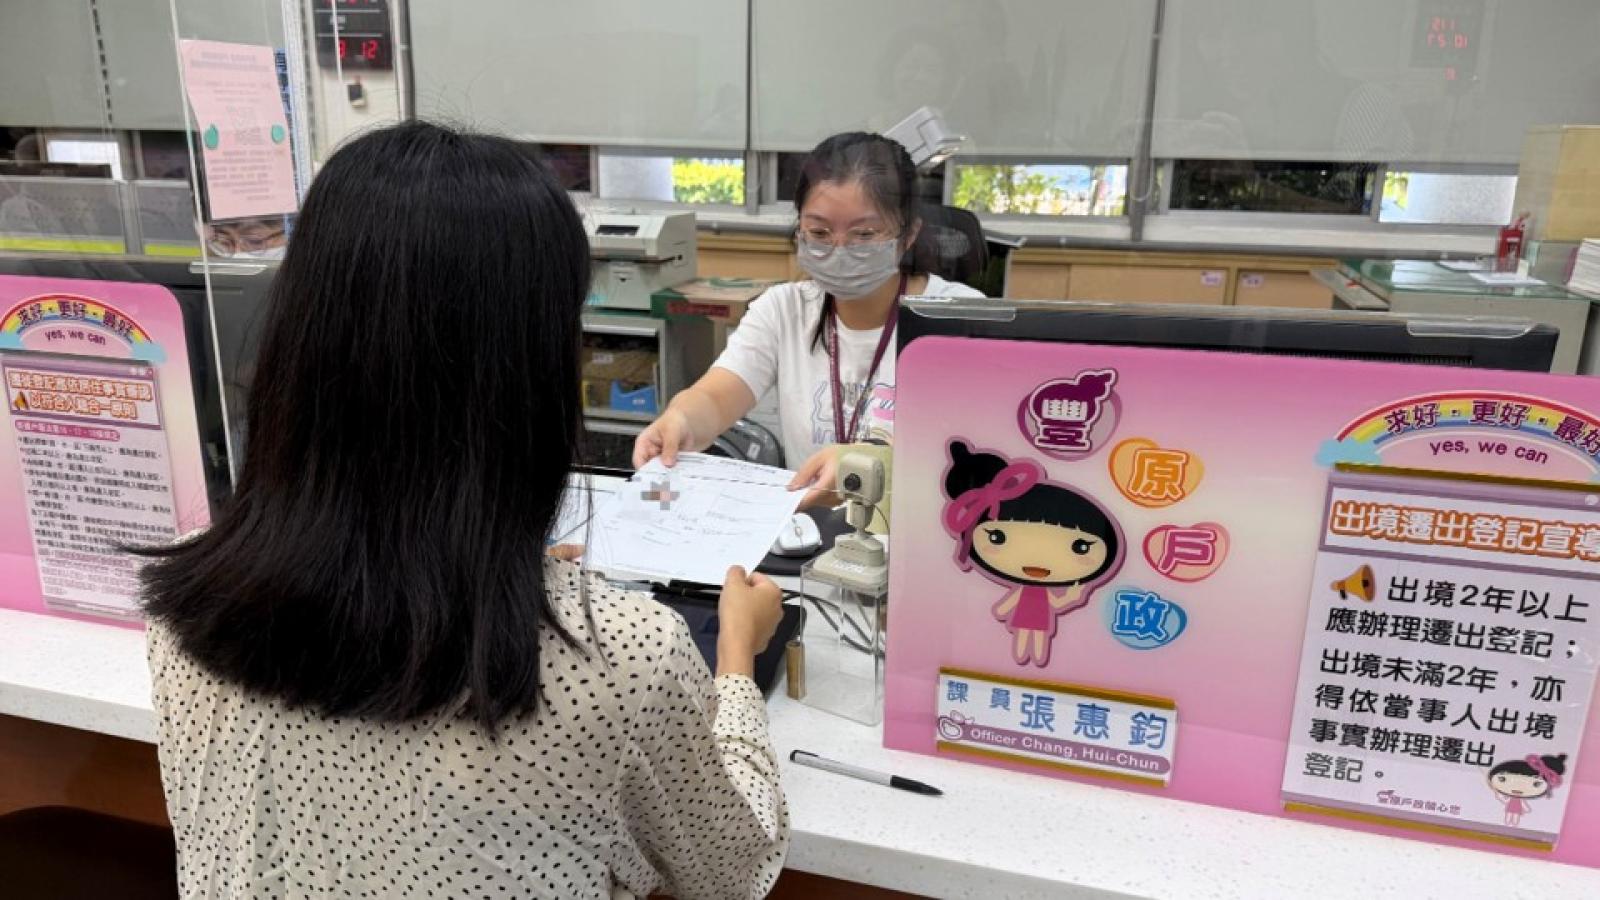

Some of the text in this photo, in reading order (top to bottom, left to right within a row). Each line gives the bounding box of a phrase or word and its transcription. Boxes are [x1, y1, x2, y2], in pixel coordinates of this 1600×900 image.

[362, 40, 378, 59] 12
[45, 329, 106, 346] yes, we can
[1429, 440, 1549, 465] yes, we can
[1333, 502, 1600, 558] 出境遷出登記宣導
[1387, 576, 1589, 624] 出境2年以上
[946, 679, 1168, 750] 課員 張惠鈞
[1314, 684, 1558, 740] 得依當事人出境
[970, 727, 1160, 771] Officer Chang, Hui-Chun
[1309, 717, 1496, 768] 事實辦理遷出
[1302, 752, 1385, 784] 登記。
